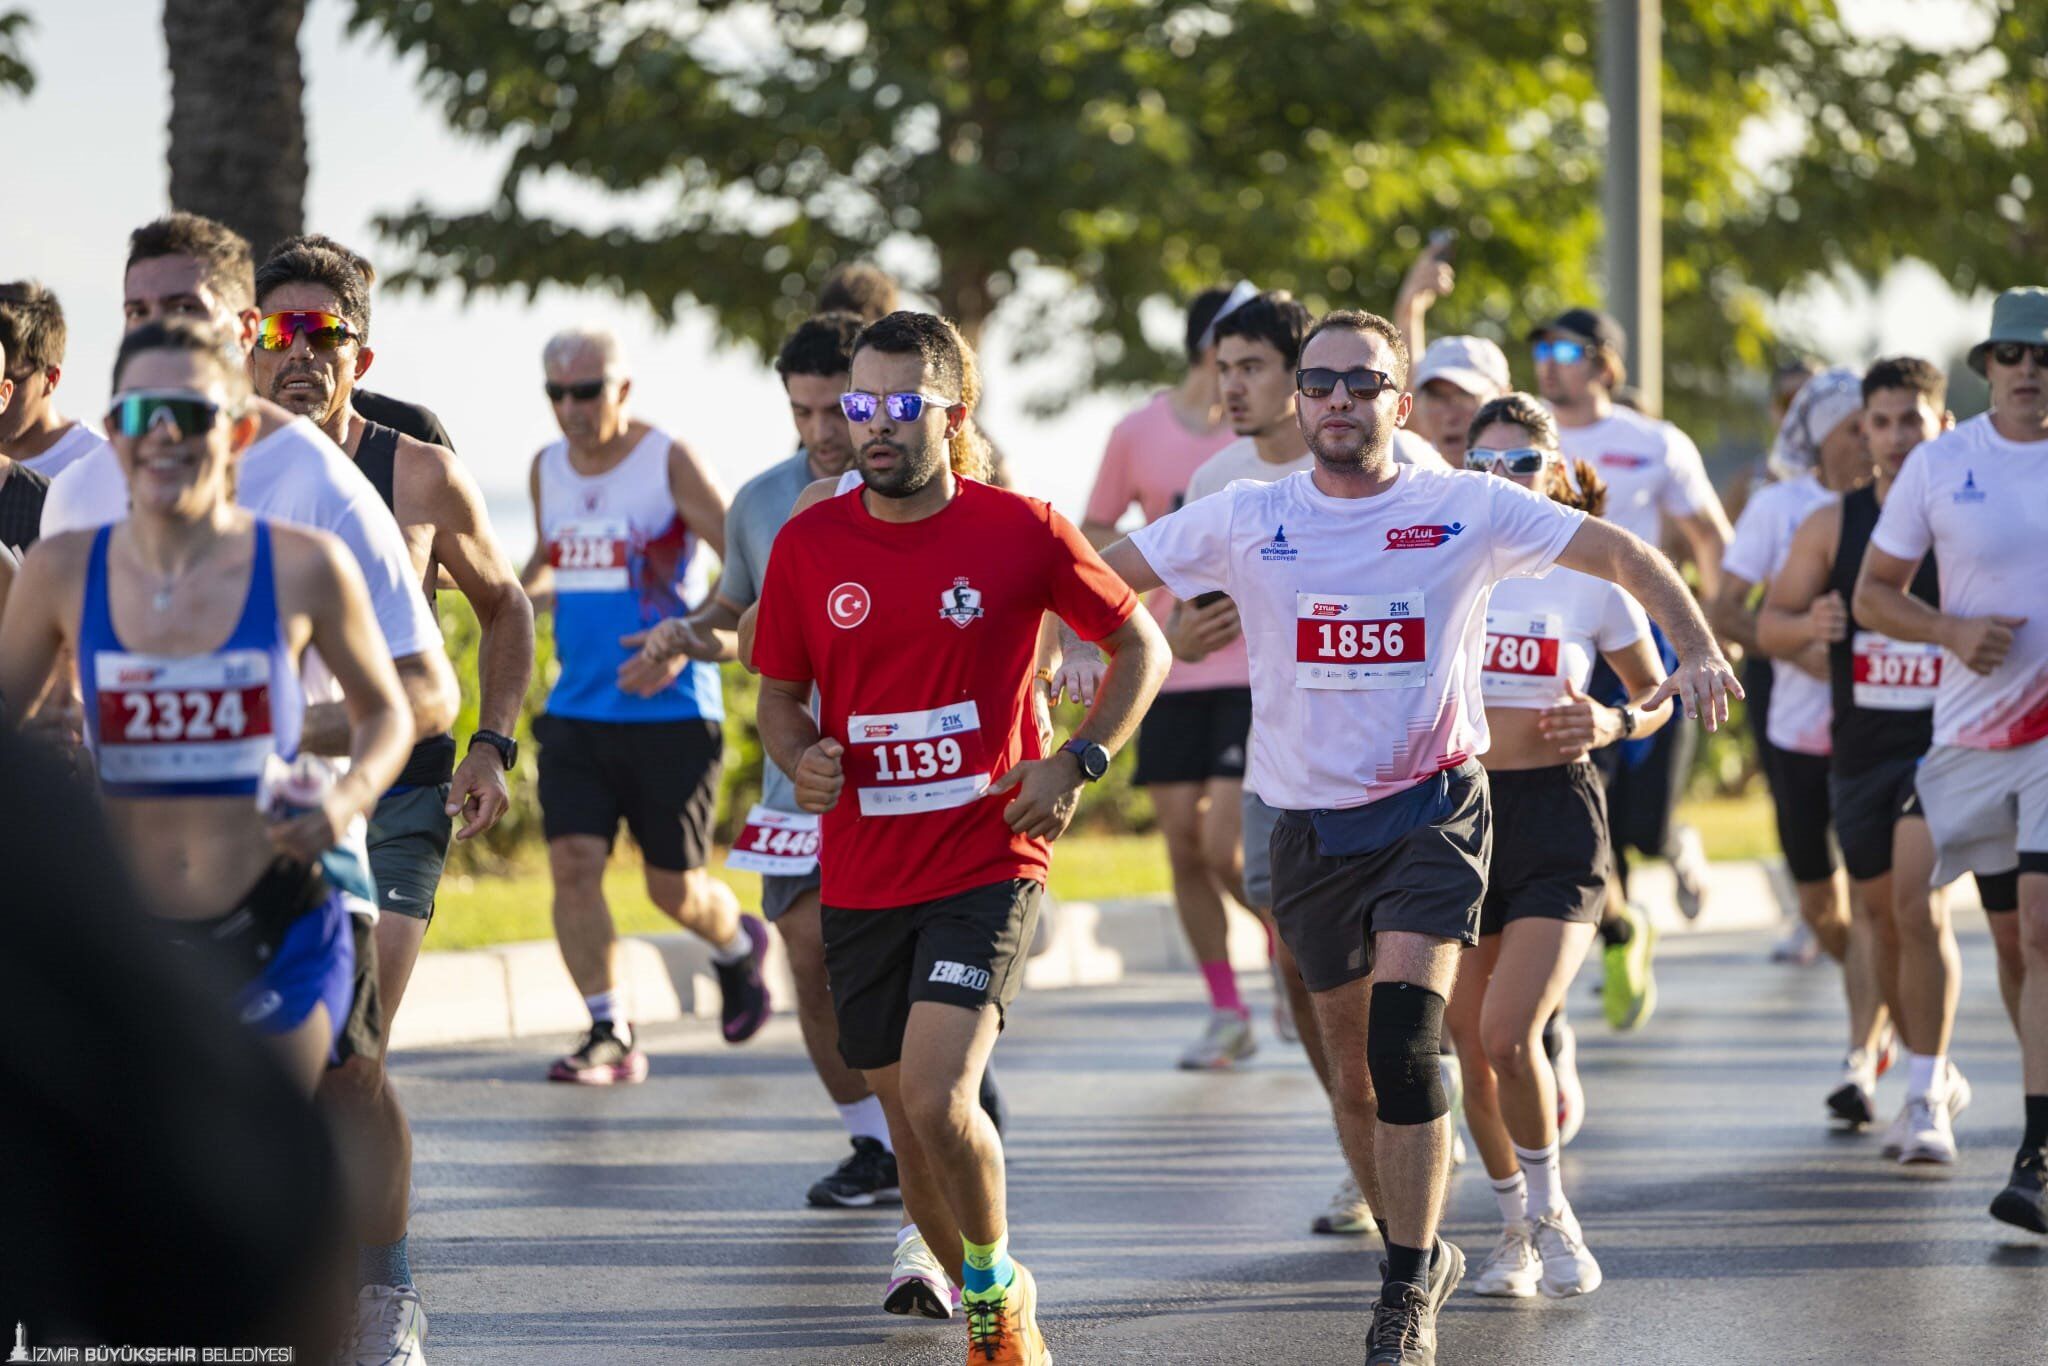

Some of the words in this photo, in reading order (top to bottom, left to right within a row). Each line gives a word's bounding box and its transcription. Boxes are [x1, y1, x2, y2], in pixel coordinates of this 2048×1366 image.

[1390, 602, 1409, 612] 21K
[1318, 622, 1404, 658] 1856
[1866, 655, 1936, 685] 3075
[122, 691, 248, 740] 2324
[940, 713, 962, 728] 21K
[873, 738, 963, 781] 1139
